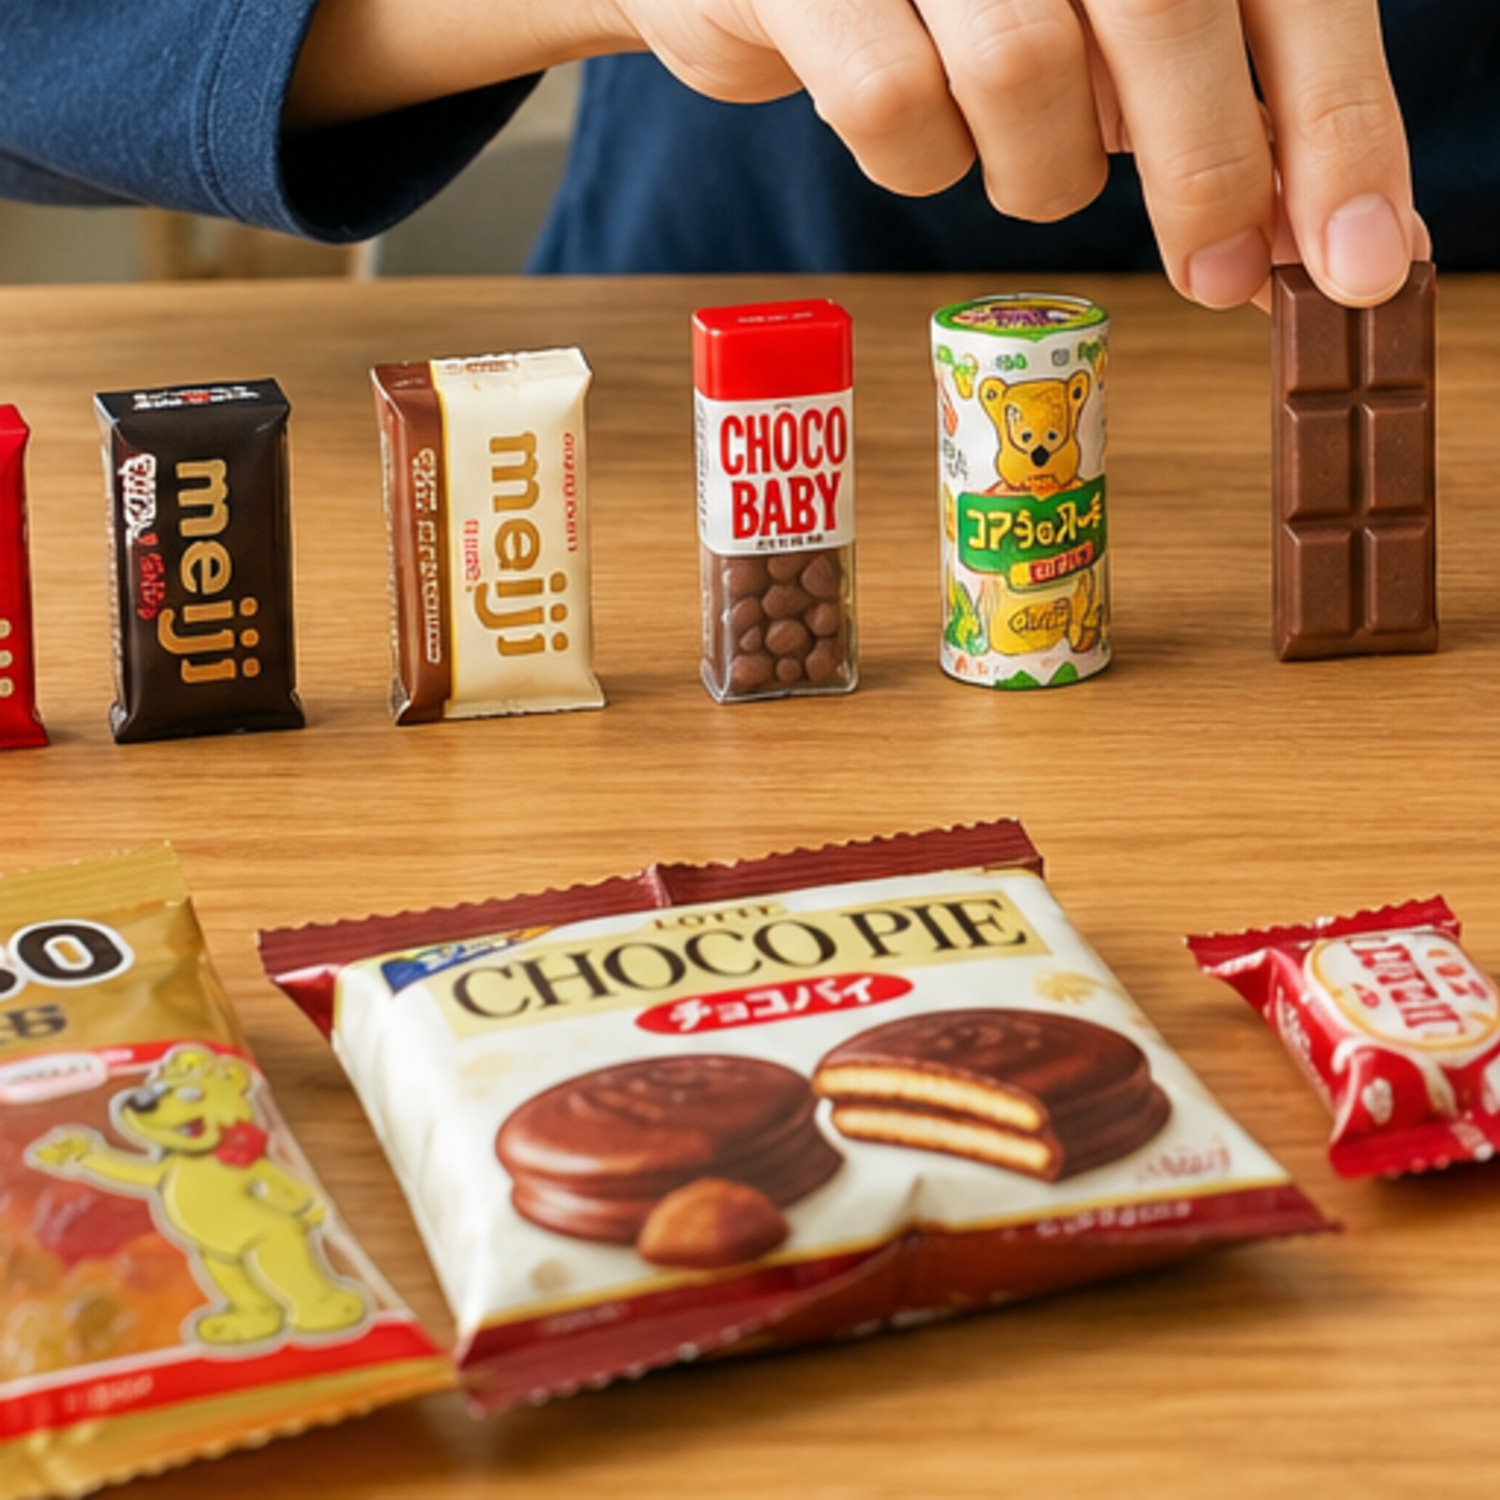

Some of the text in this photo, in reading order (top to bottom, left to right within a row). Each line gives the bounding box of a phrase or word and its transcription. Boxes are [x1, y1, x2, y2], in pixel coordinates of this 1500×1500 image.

[719, 405, 848, 476] CHOCO
[473, 430, 569, 657] meiji
[731, 470, 842, 540] BABY
[157, 458, 261, 685] meiji
[451, 919, 838, 1021] CHOCO
[840, 897, 1028, 959] PIE
